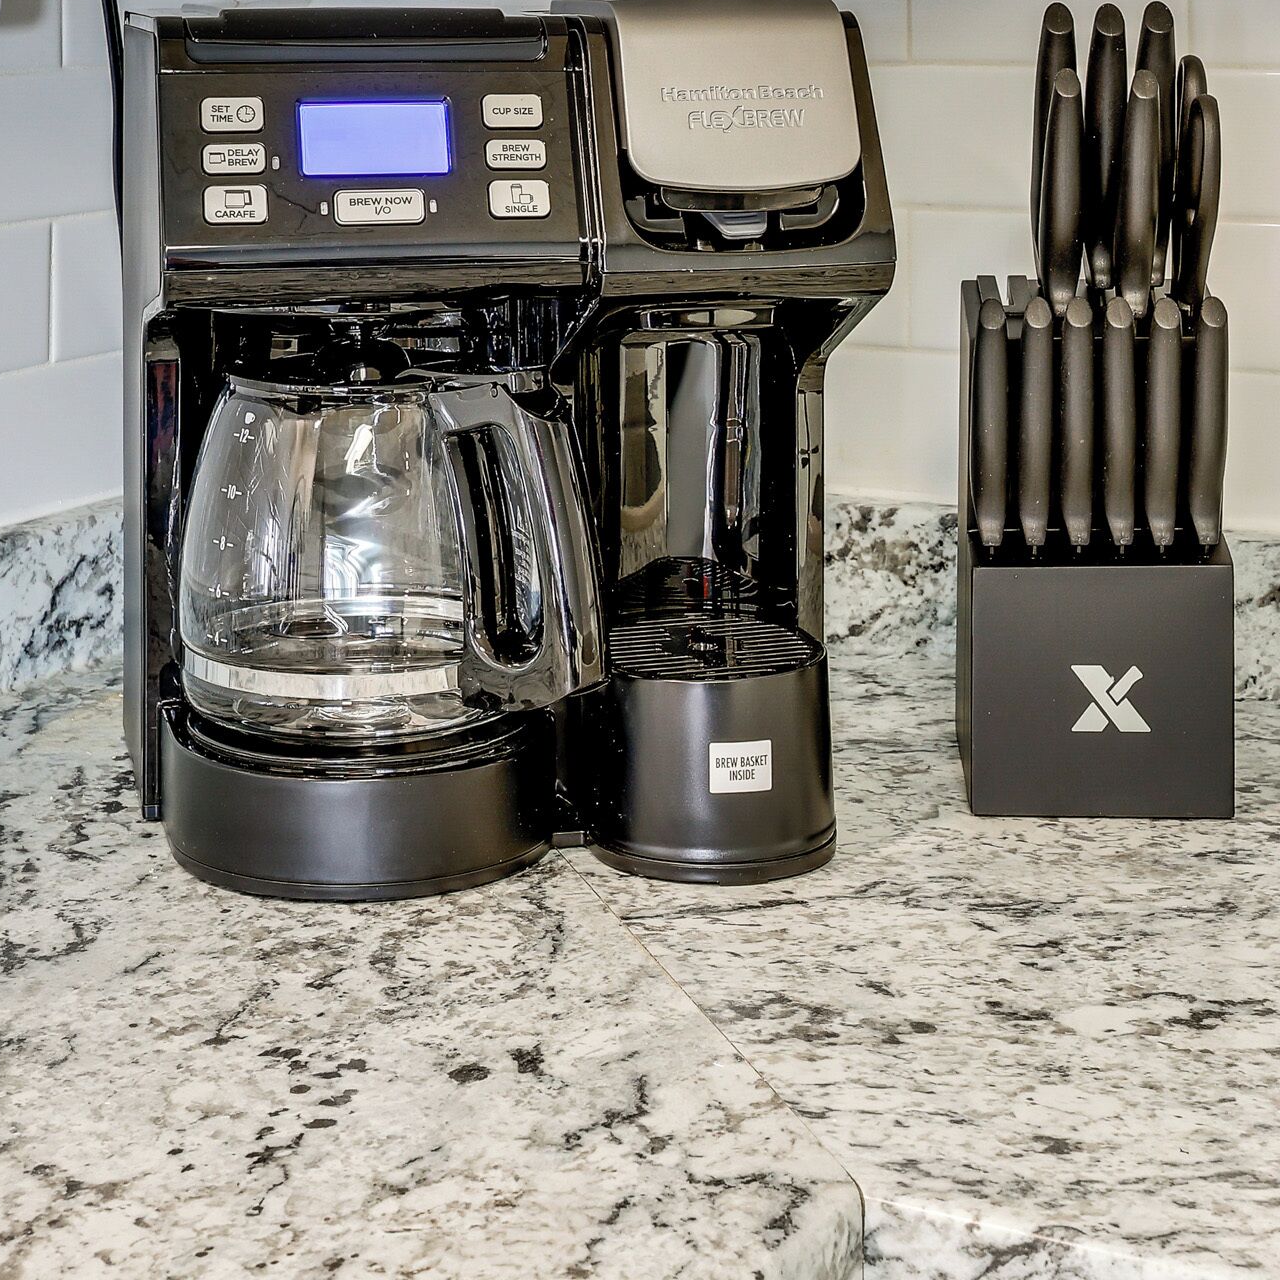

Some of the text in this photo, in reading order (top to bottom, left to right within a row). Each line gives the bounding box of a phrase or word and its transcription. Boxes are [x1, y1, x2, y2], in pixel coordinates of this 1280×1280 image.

[660, 85, 823, 102] Hamilton Beach
[211, 105, 231, 114] SET
[492, 106, 534, 116] CUP SIZE
[210, 114, 233, 123] TIME
[227, 149, 260, 157] DELAY
[502, 144, 530, 153] BREW
[227, 158, 258, 166] BREW
[492, 152, 542, 162] STRENGTH
[349, 197, 413, 207] BREW NOW
[215, 210, 256, 218] CARAFE
[505, 204, 539, 214] SINGLE
[240, 428, 250, 443] 12
[227, 484, 237, 500] 10
[715, 754, 768, 768] BREW BASKET
[729, 769, 755, 781] INSIDE
